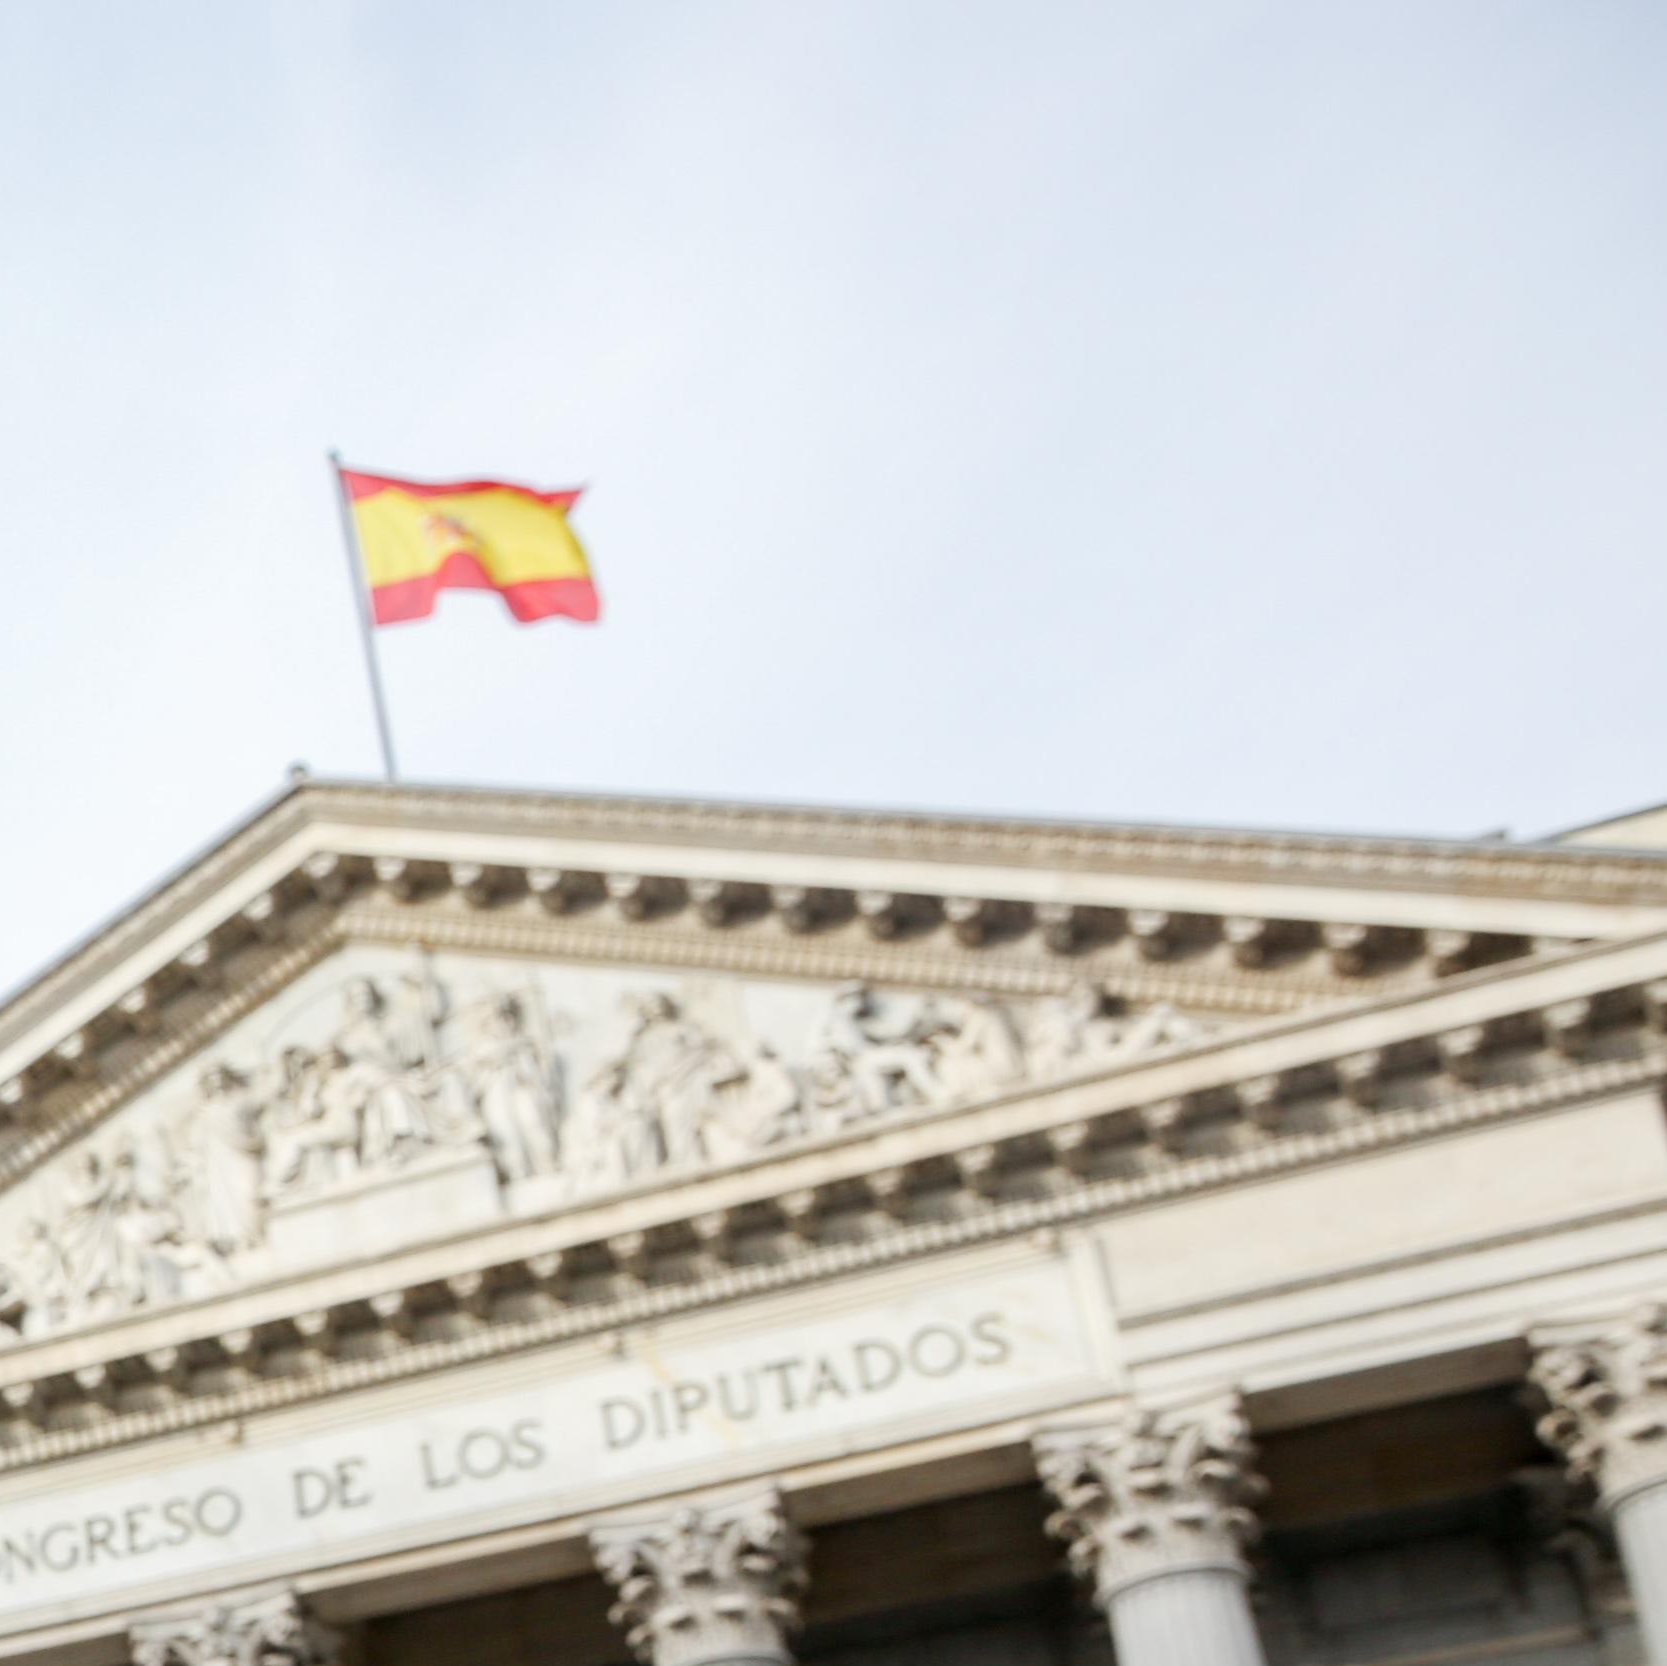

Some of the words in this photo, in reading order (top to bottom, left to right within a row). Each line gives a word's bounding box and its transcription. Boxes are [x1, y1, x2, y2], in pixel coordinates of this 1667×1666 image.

[292, 1457, 374, 1519] DE
[419, 1417, 546, 1491] LOS
[600, 1311, 1013, 1450] DIPUTADOS
